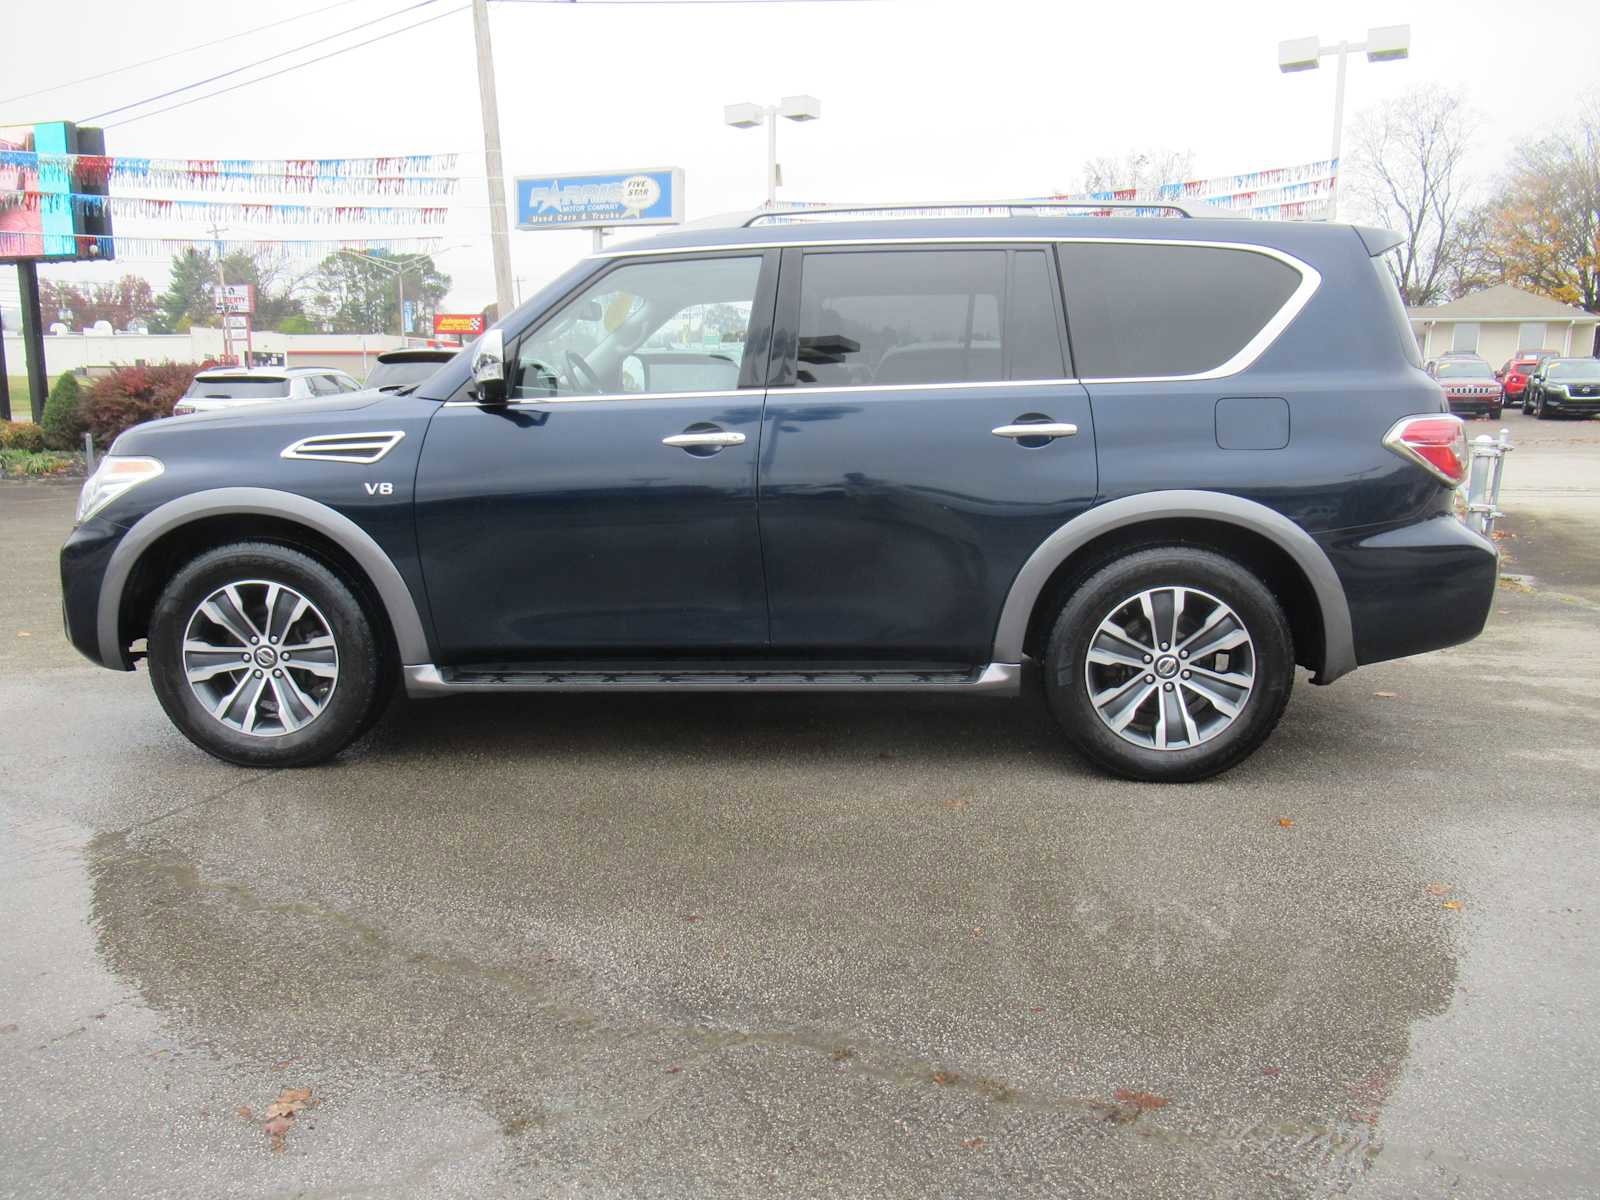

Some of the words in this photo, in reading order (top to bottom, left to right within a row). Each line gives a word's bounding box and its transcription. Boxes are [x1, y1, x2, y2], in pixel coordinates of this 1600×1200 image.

[627, 180, 647, 188] FIVE
[627, 188, 650, 197] STAR
[532, 214, 553, 223] Used
[557, 213, 577, 221] Cars
[592, 210, 623, 219] Trucks
[364, 482, 393, 496] V8
